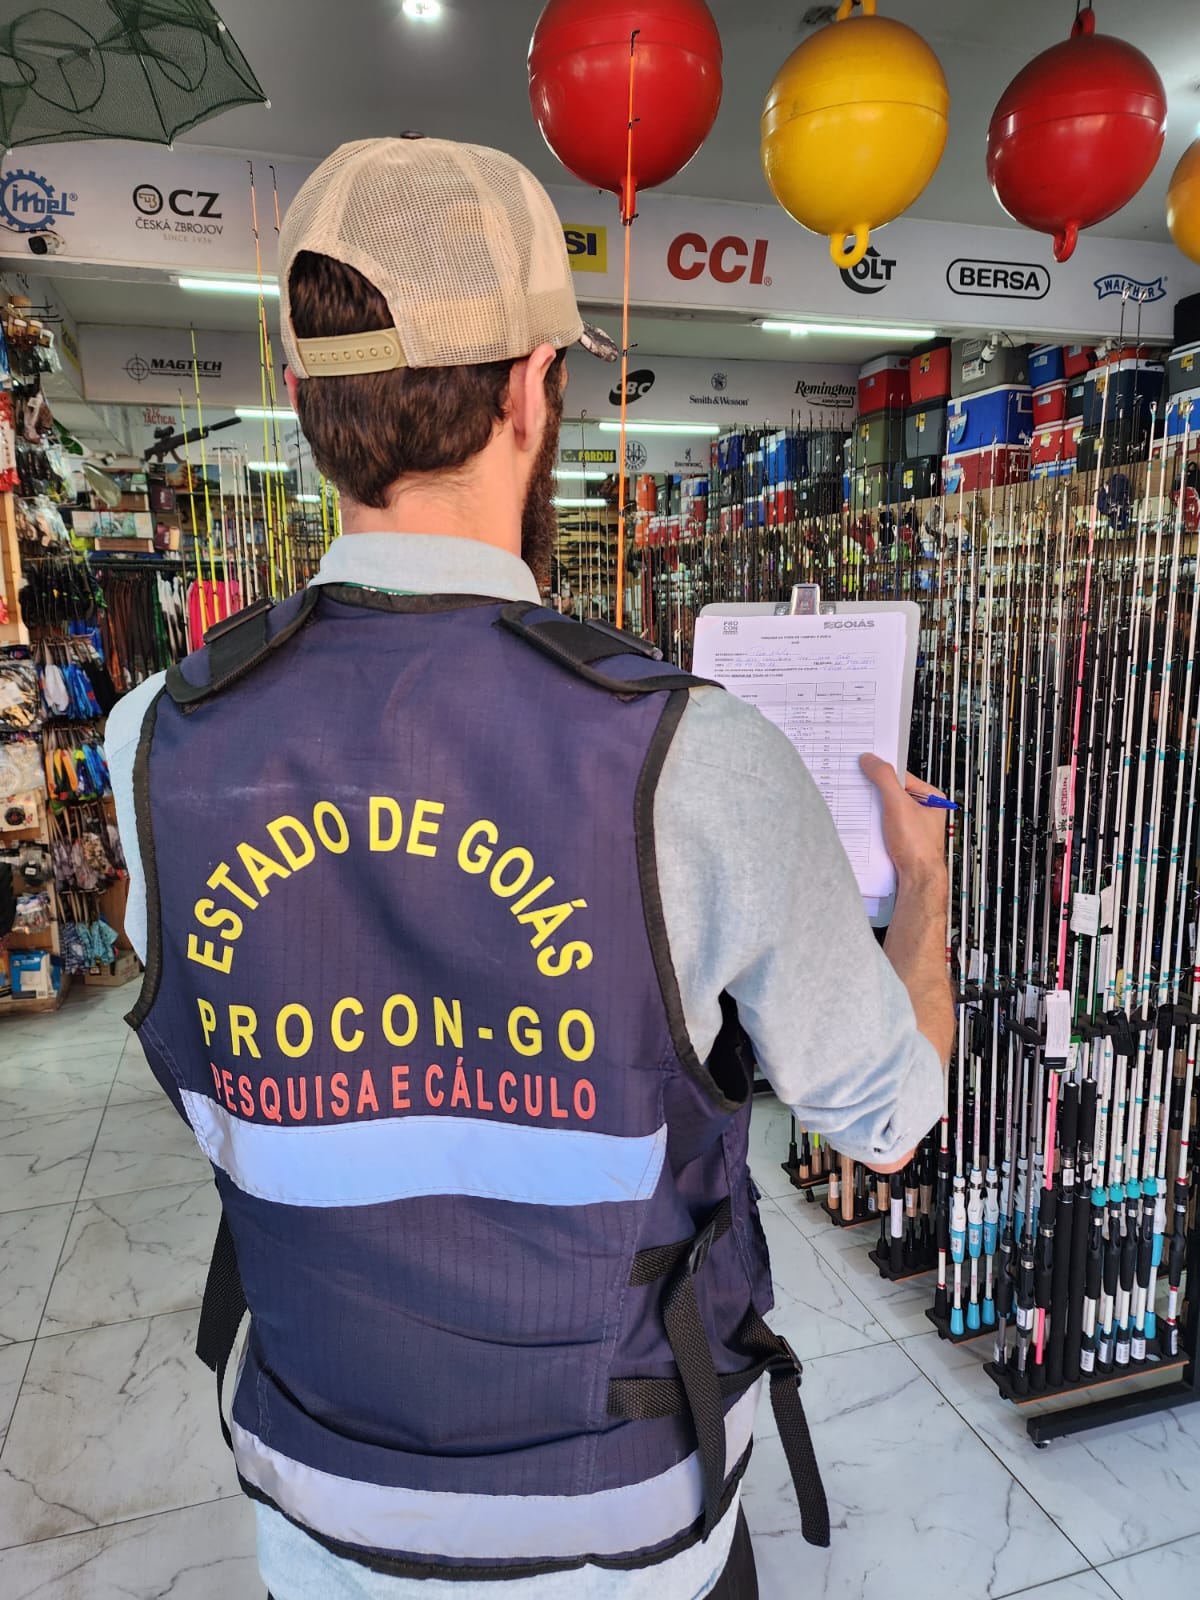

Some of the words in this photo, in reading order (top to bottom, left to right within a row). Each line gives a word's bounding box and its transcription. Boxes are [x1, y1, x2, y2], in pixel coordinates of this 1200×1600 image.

[168, 189, 222, 219] CZ
[135, 217, 171, 231] ČESKÁ
[174, 221, 224, 235] ZBROJOV
[667, 232, 769, 285] CCI
[960, 267, 1040, 291] BERSA
[151, 359, 223, 371] MAGTECH
[794, 381, 857, 397] Remington
[834, 618, 875, 629] GOIÁS
[187, 801, 349, 973] ESTADO
[369, 796, 445, 856] DE
[457, 819, 592, 976] GOIÁS
[198, 994, 595, 1062] PROCON-GO
[211, 1064, 379, 1122] PESQUISA
[392, 1066, 410, 1109] E
[425, 1058, 595, 1120] CÁLCULO
